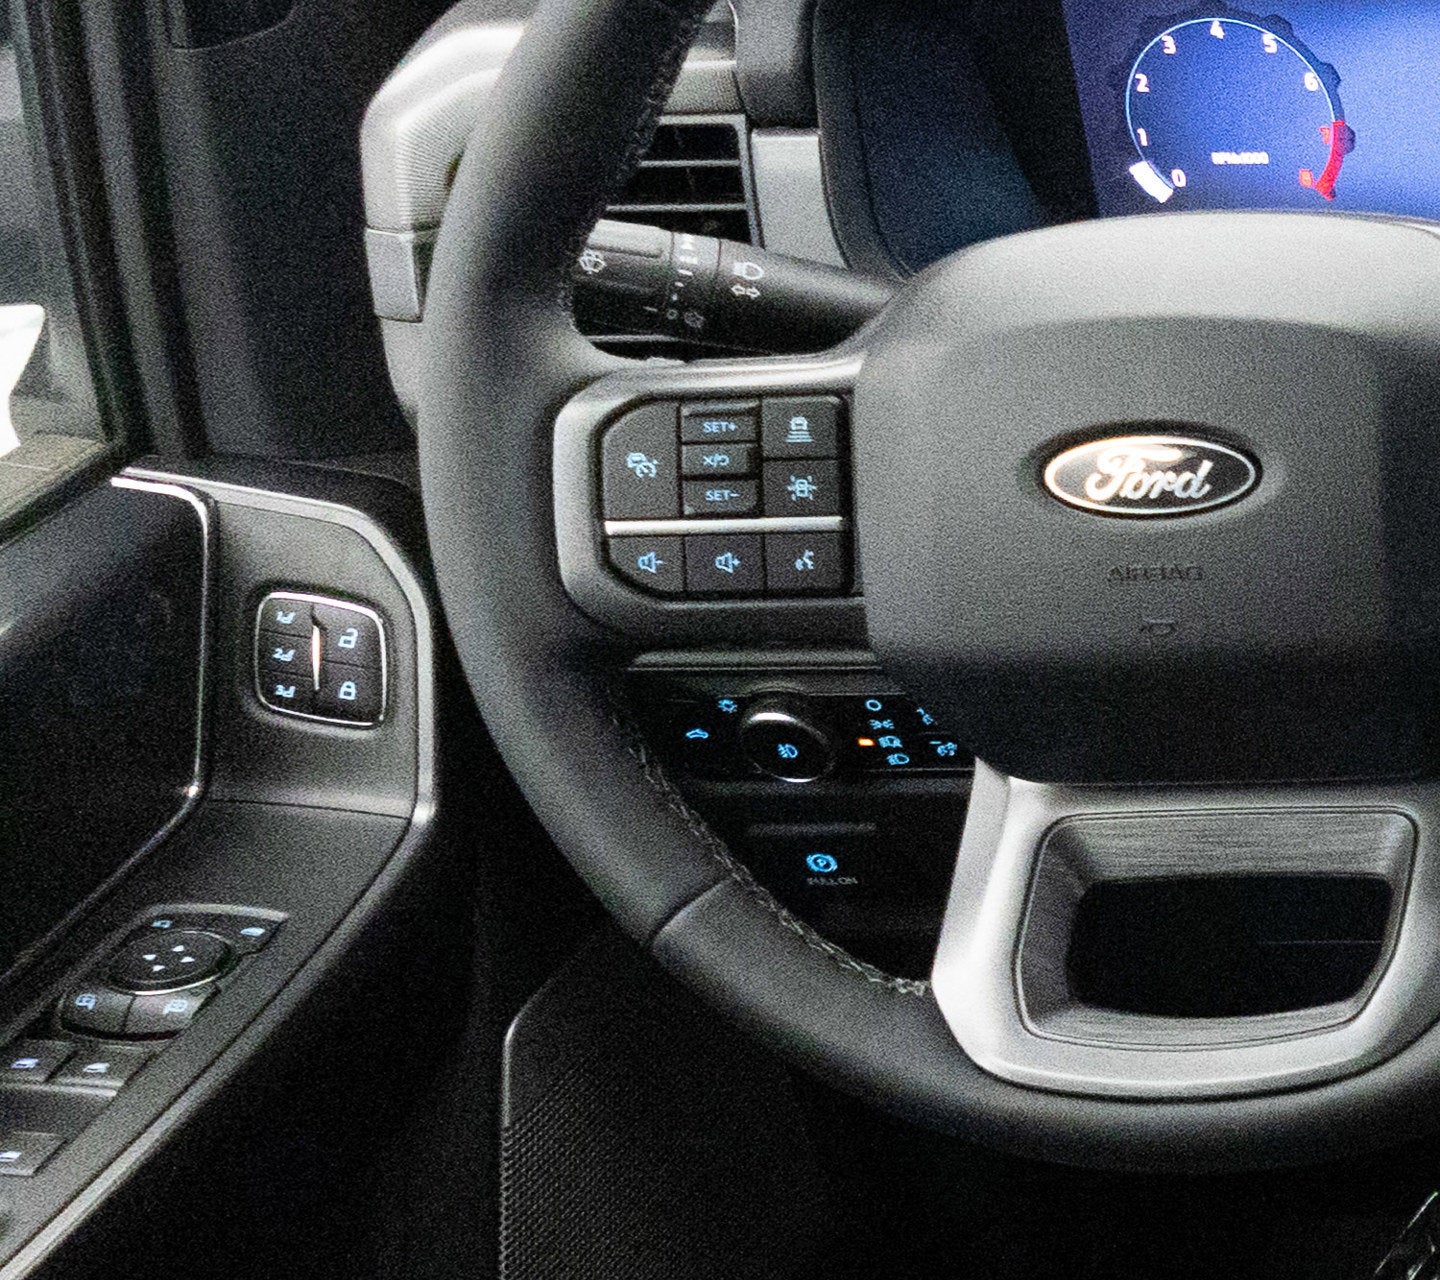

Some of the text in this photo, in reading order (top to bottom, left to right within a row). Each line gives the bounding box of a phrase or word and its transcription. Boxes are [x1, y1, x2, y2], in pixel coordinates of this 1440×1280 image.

[1209, 20, 1225, 40] 4
[1161, 35, 1177, 54] 3
[1261, 33, 1278, 54] 5
[1134, 73, 1150, 93] 2
[1303, 72, 1319, 92] 6
[1136, 128, 1148, 146] 1
[1171, 168, 1187, 188] 0
[1085, 444, 1214, 502] Ford
